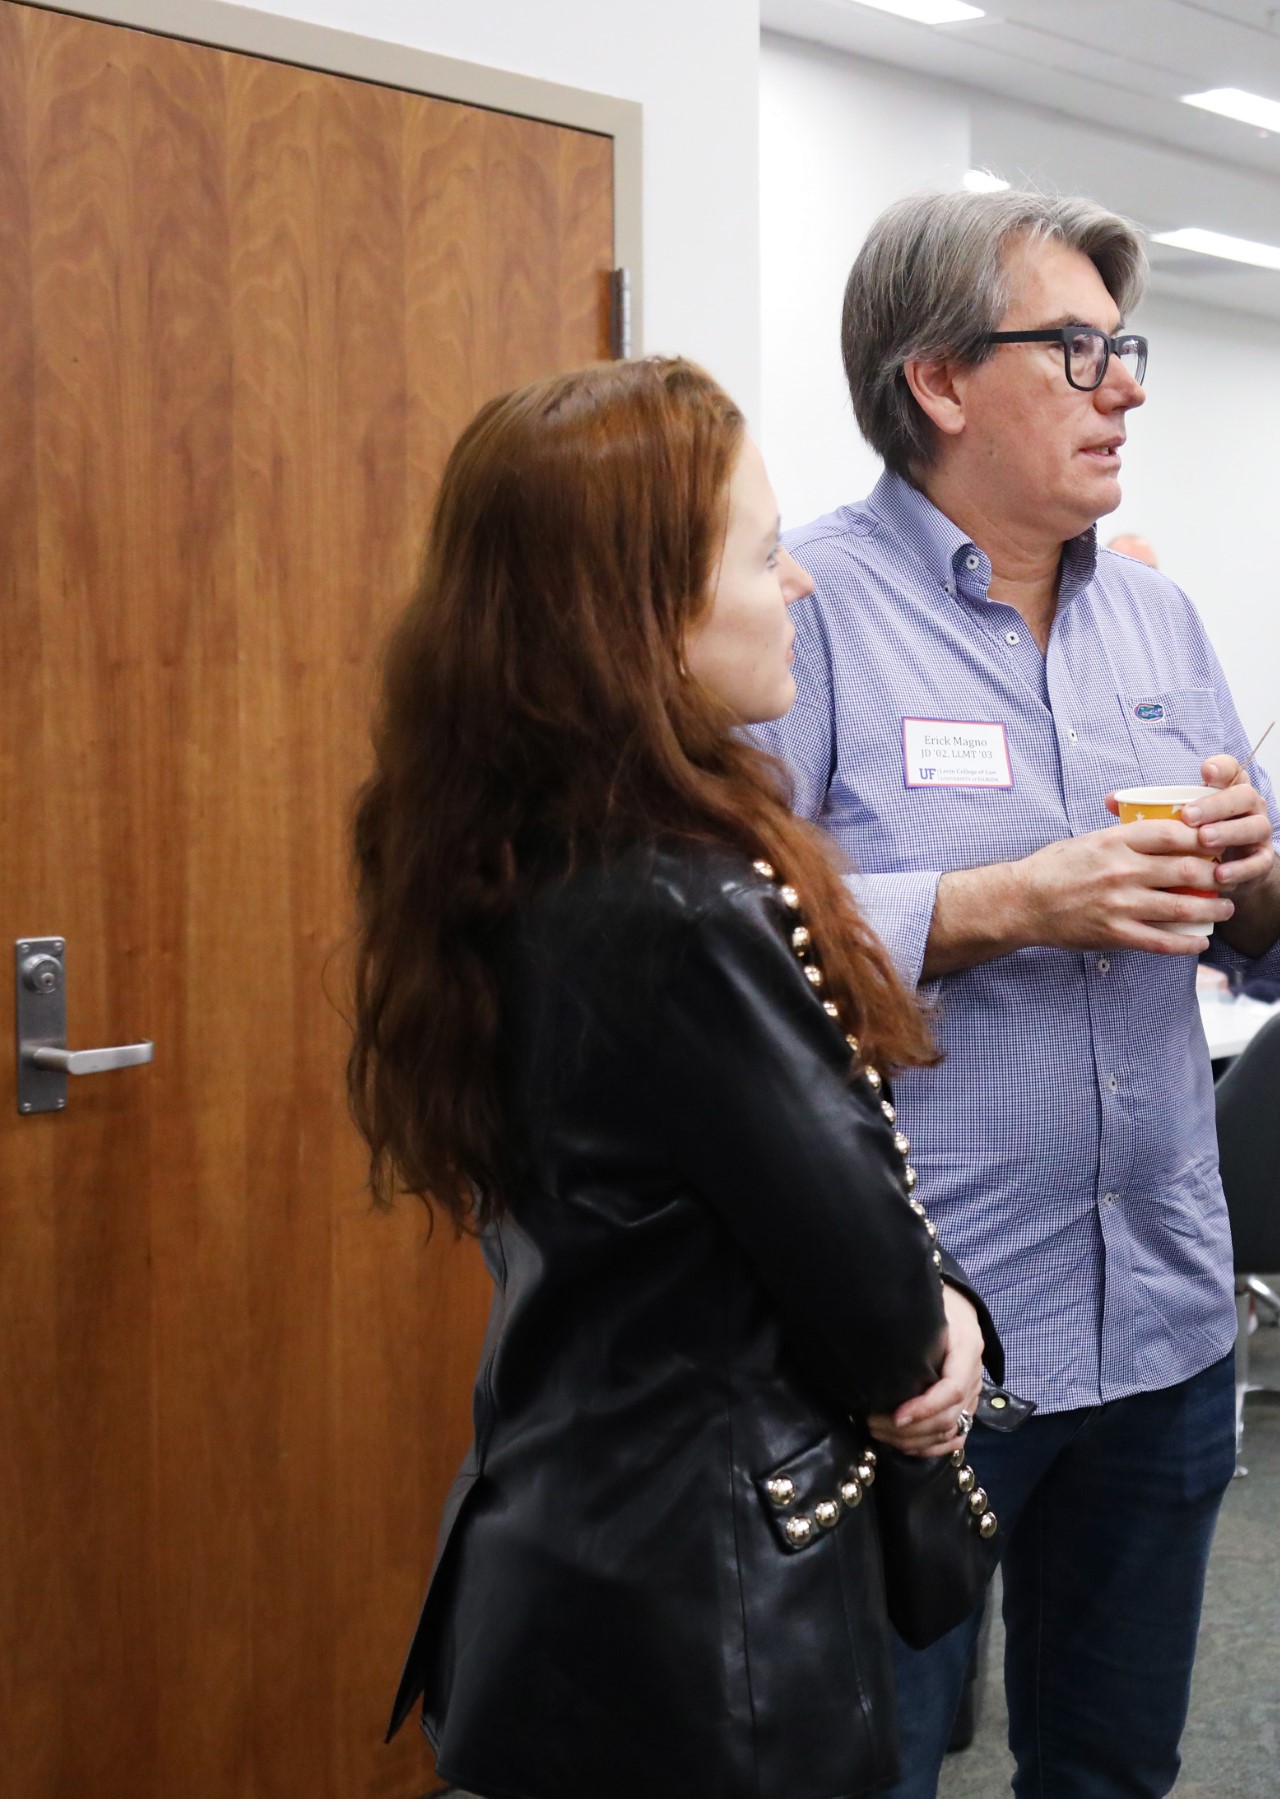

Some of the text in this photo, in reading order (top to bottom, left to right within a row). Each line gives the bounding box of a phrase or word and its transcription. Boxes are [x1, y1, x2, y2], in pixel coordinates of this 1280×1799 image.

[924, 735, 988, 748] Erick Magno
[921, 749, 931, 759] JD
[919, 768, 936, 780] UF
